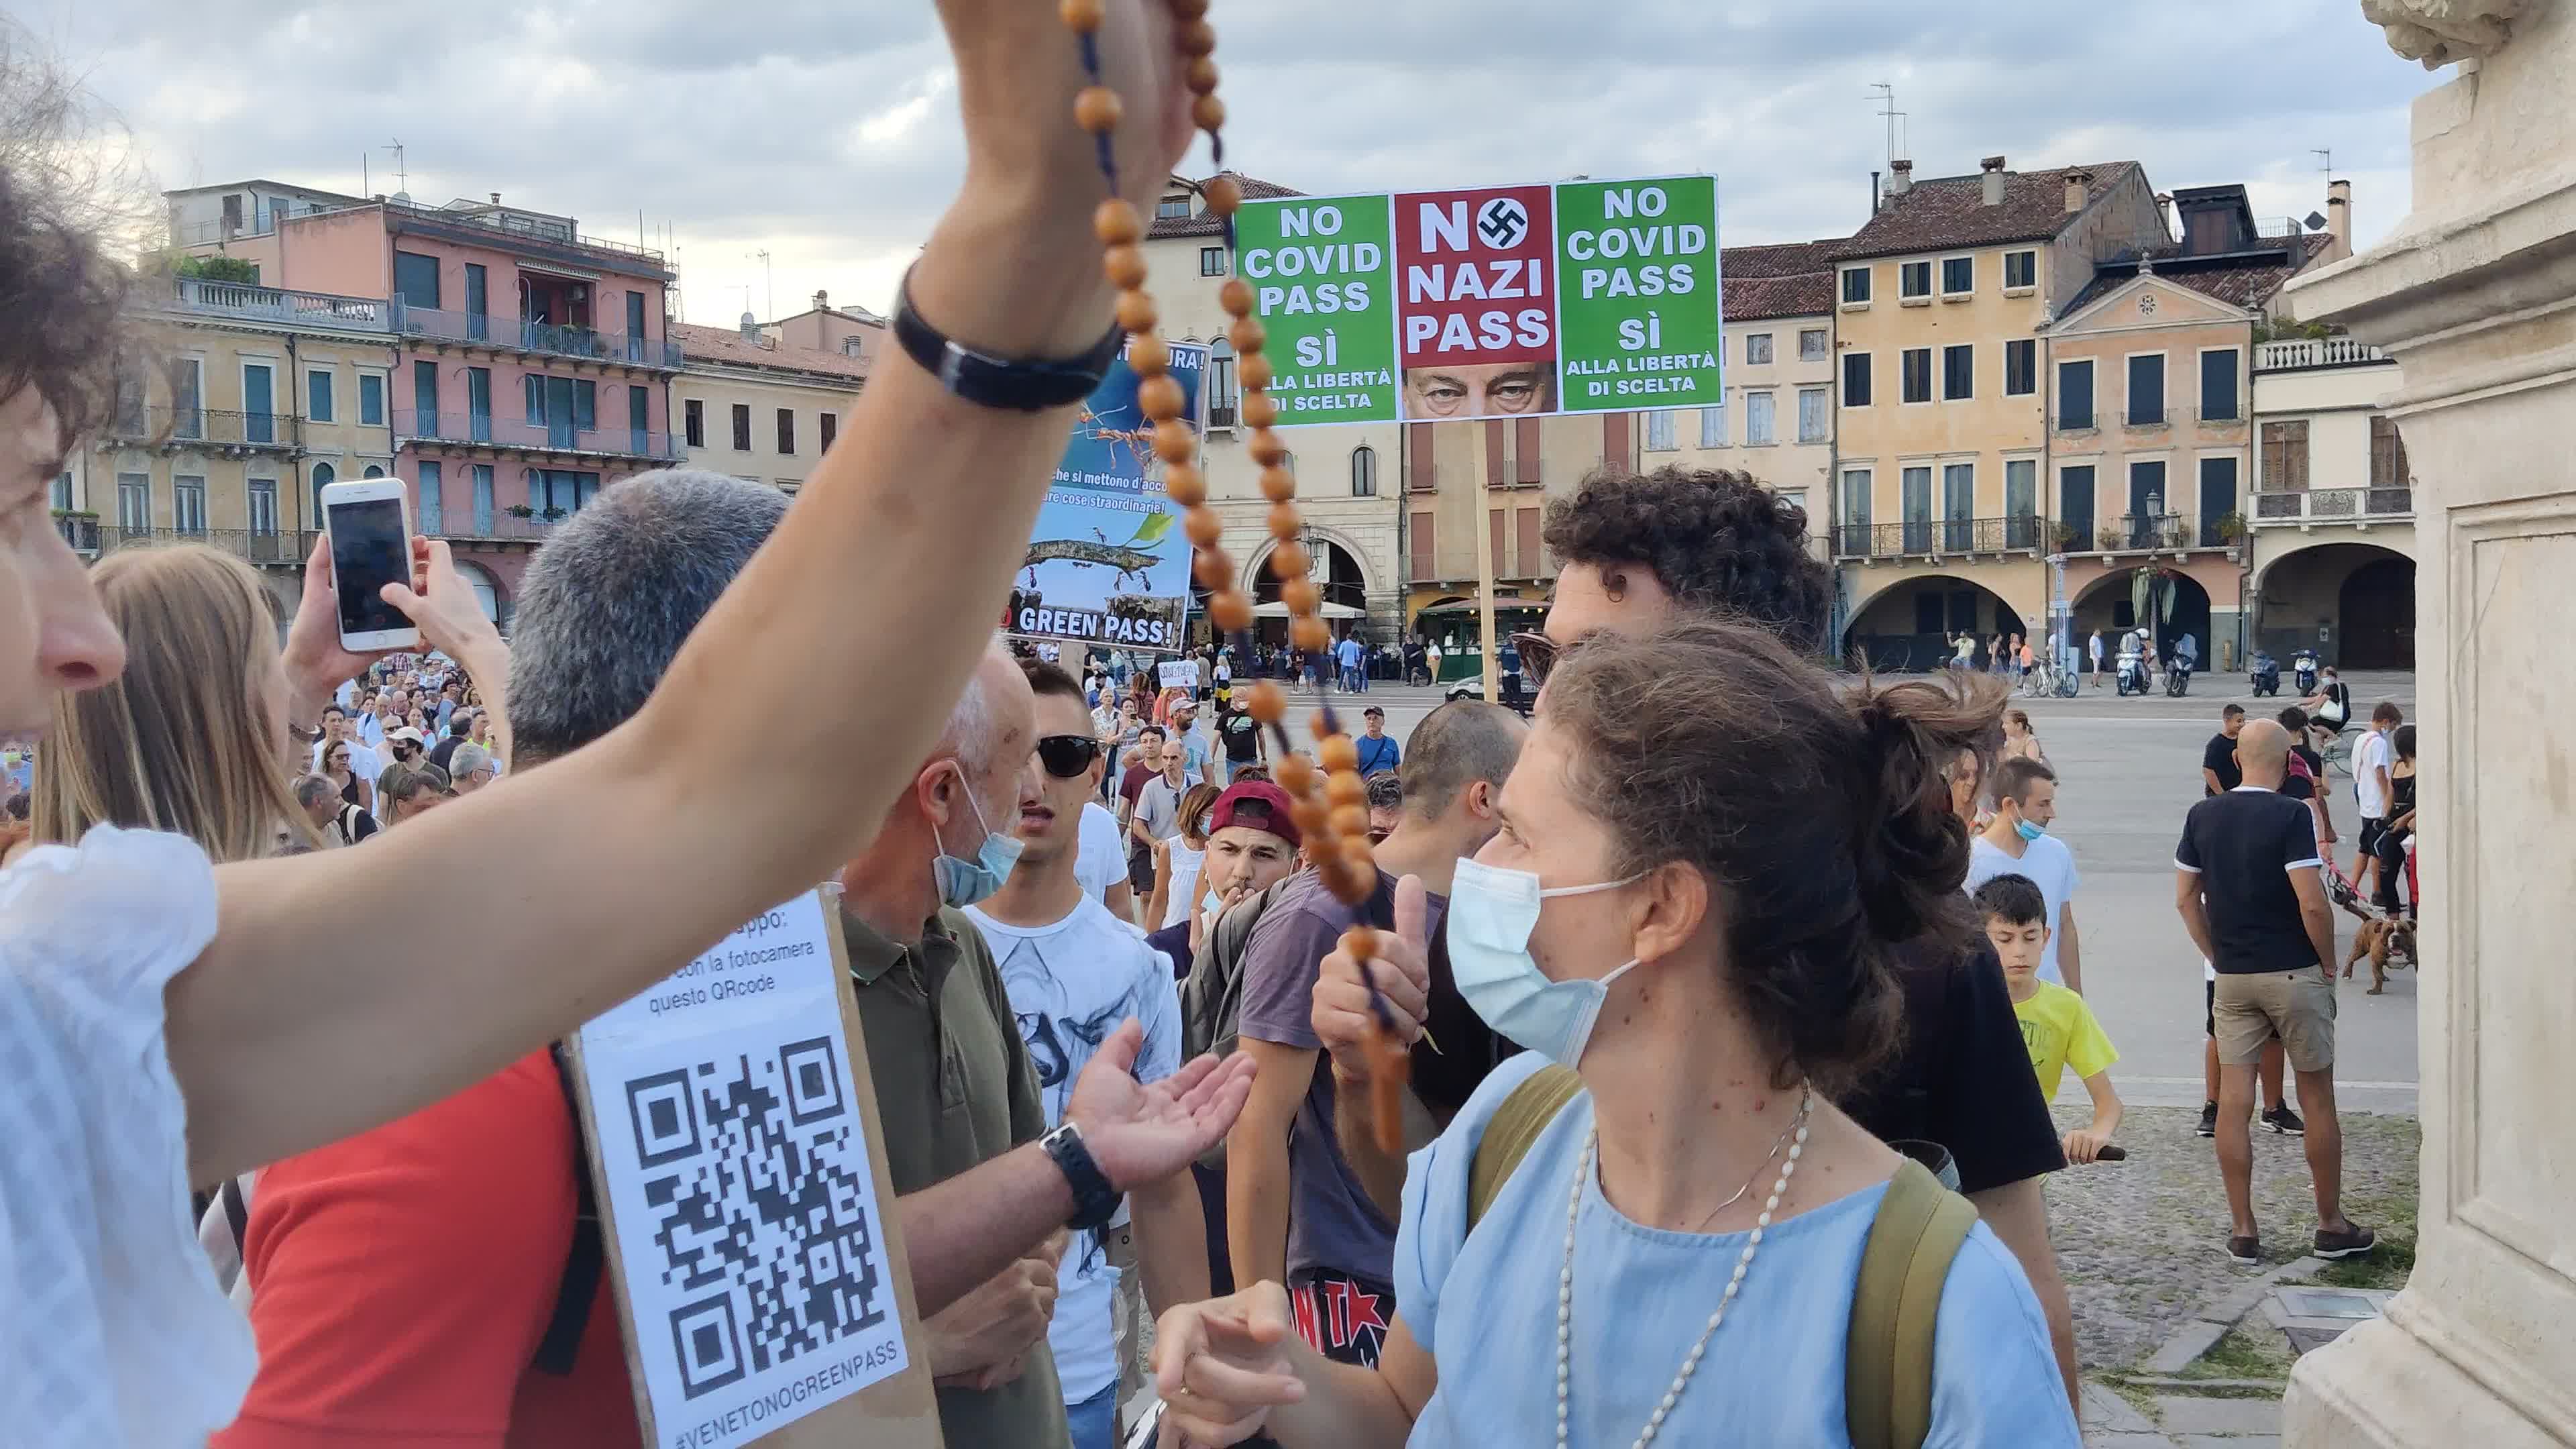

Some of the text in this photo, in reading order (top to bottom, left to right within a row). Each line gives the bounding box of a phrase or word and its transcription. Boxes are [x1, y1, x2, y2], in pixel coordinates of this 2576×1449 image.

[1279, 204, 1343, 238] NO
[1603, 186, 1668, 220] NO
[1244, 242, 1382, 279] COVID
[1566, 225, 1707, 261] COVID
[1259, 281, 1371, 317] PASS
[1407, 258, 1543, 304] NAZI
[1582, 264, 1695, 300] PASS
[1295, 327, 1338, 368] SÌ
[1406, 309, 1550, 354] PASS
[1618, 311, 1662, 351] SÌ
[1245, 367, 1393, 392] LA LIBERTÀ
[1566, 350, 1716, 376] ALLA LIBERTÀ
[1293, 393, 1373, 411] SCELTA
[1588, 376, 1696, 396] DI SCELTA
[1083, 472, 1130, 489] mettono
[1062, 494, 1087, 506] cose
[1090, 494, 1165, 514] straordinarie!
[1019, 606, 1099, 637] GREEN
[1104, 614, 1174, 645] PASS!
[708, 955, 724, 973] la
[729, 939, 815, 969] fotocamera
[649, 974, 775, 1016] questo QRcode
